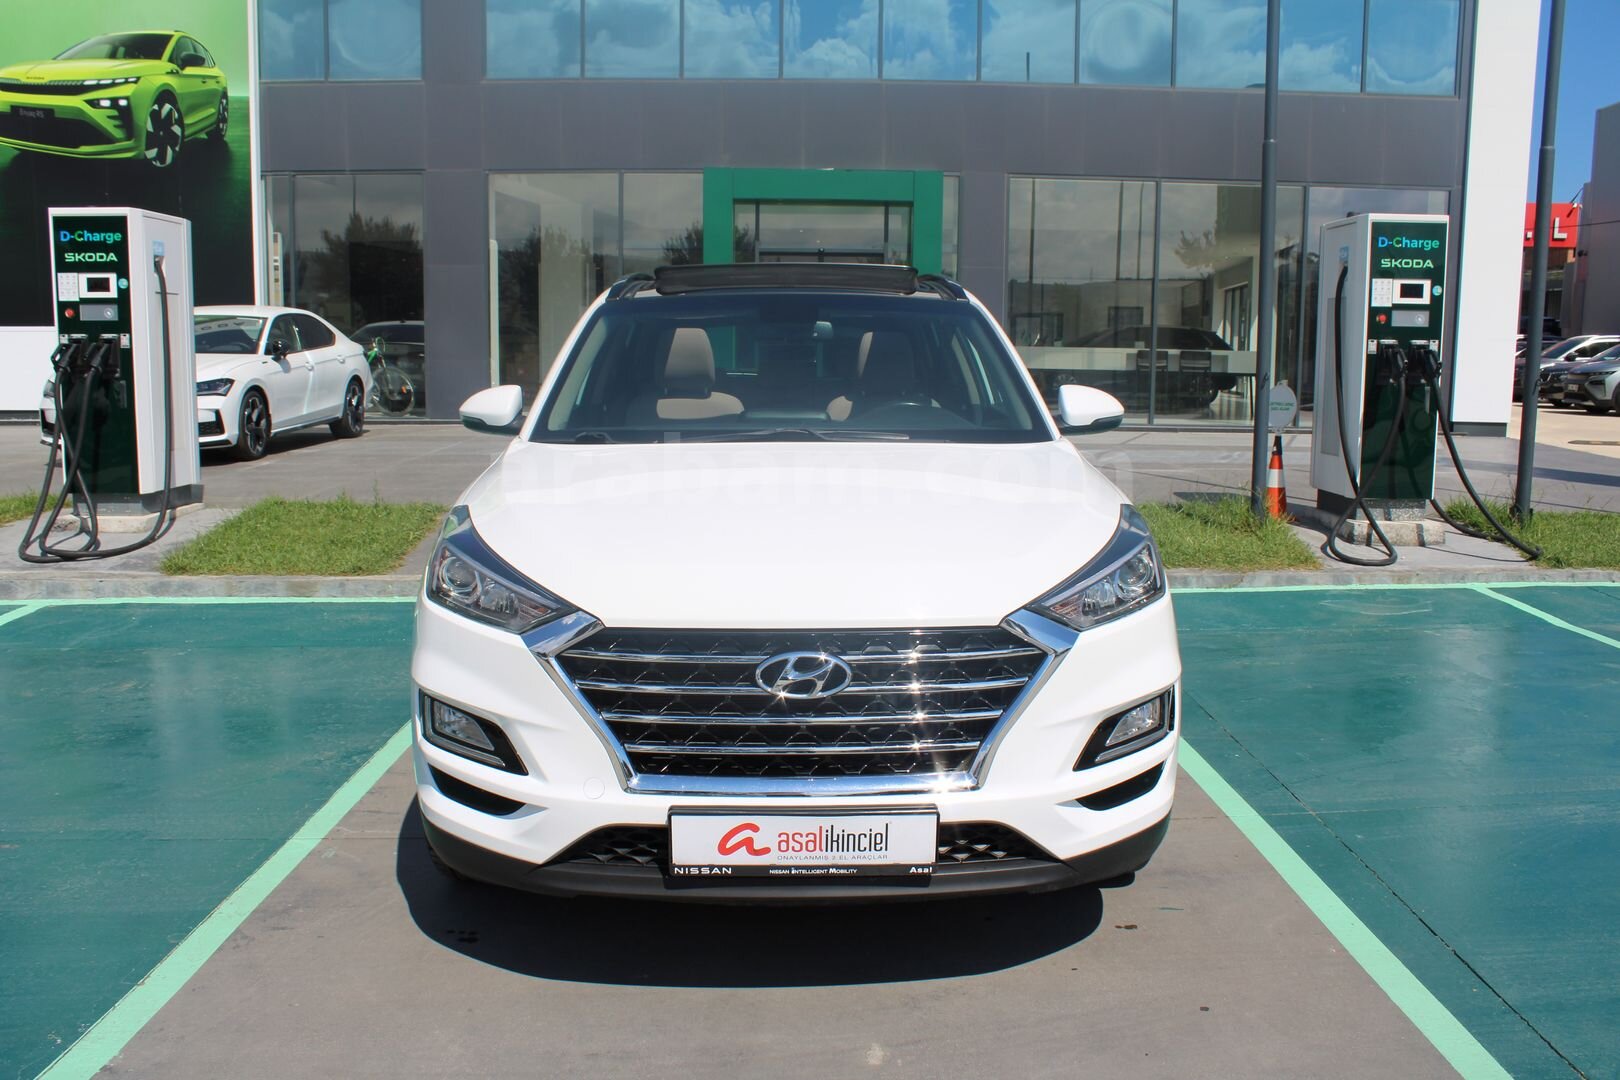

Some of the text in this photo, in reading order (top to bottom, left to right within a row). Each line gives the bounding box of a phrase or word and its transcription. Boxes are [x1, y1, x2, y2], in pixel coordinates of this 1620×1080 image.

[60, 230, 122, 244] D-Charge
[1378, 236, 1440, 251] D-Charge
[674, 867, 732, 875] NISSAN
[909, 866, 933, 874] Asal
